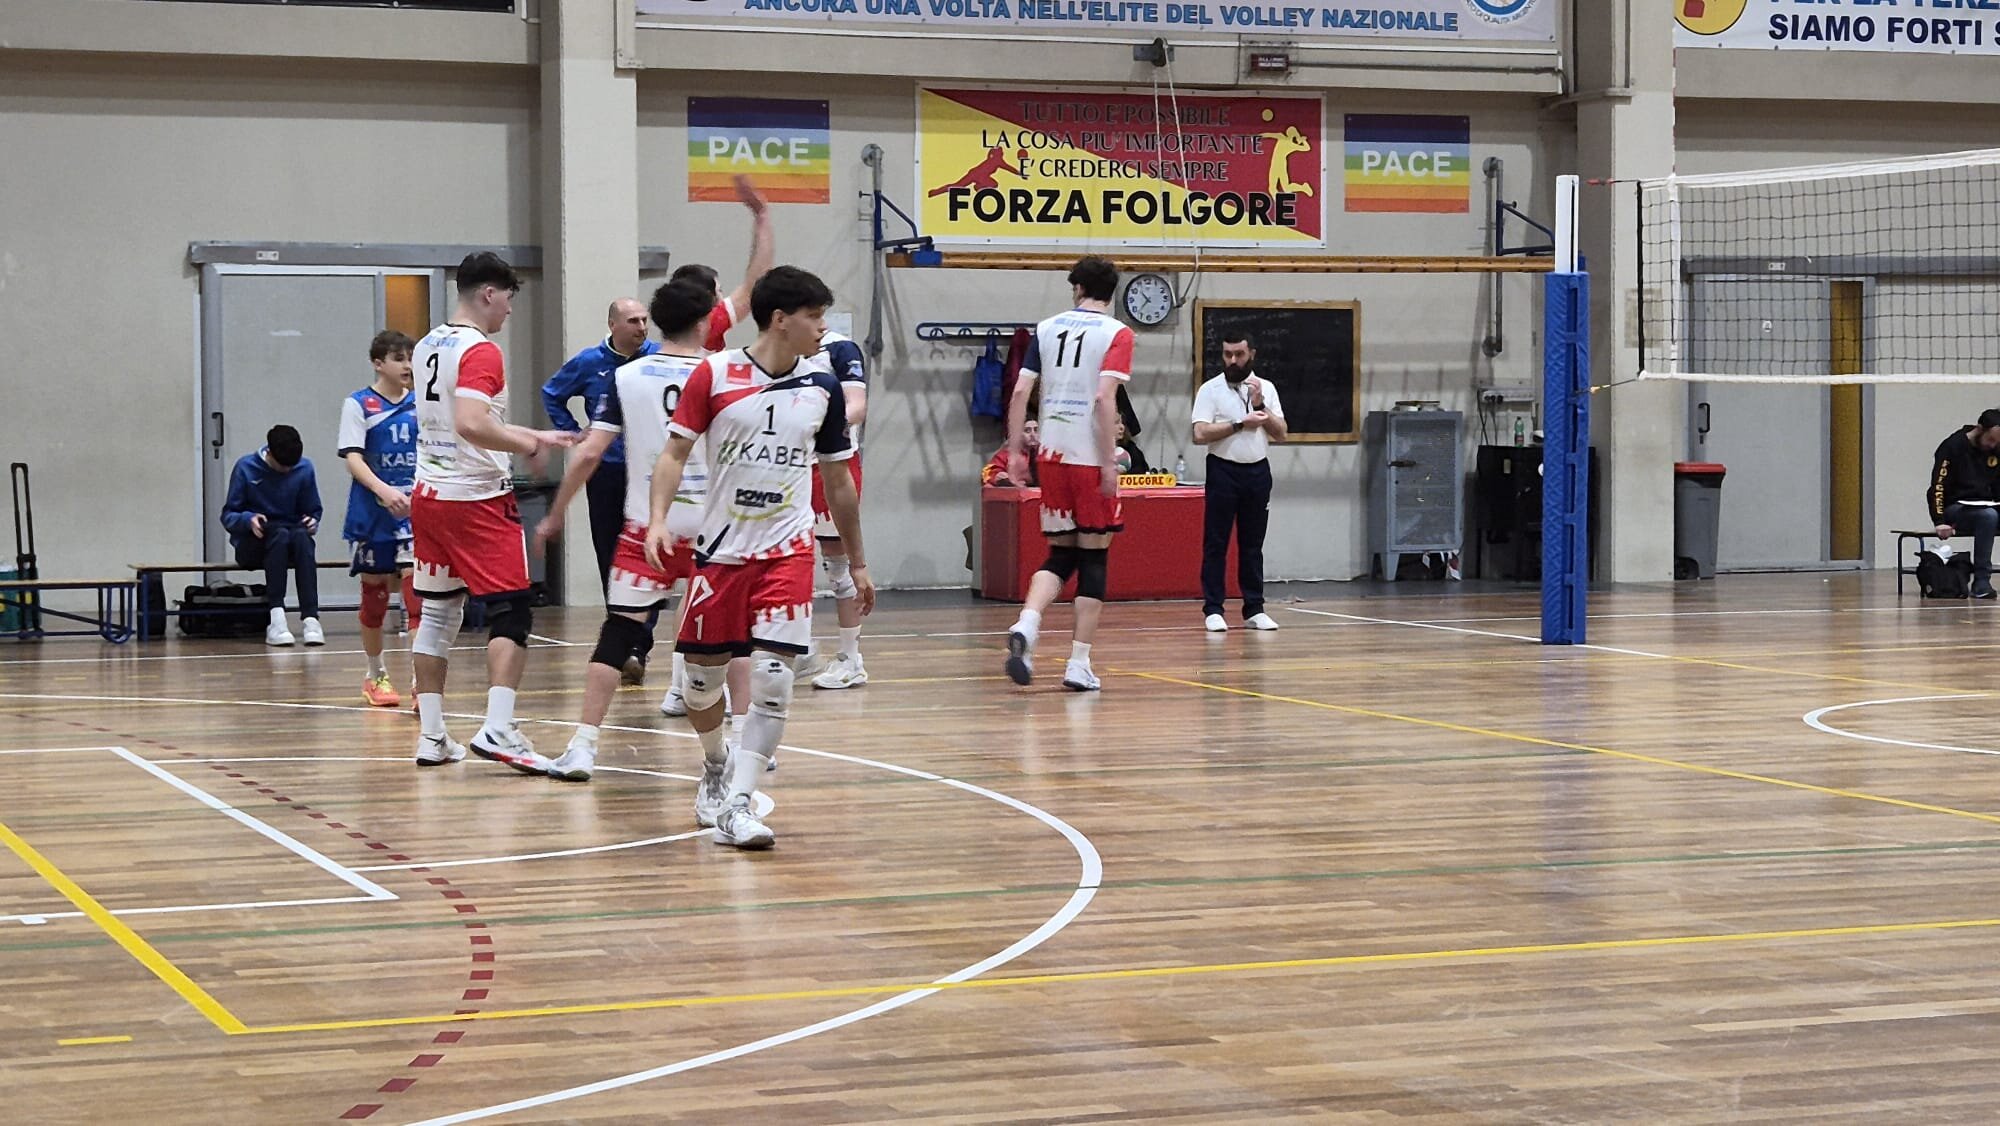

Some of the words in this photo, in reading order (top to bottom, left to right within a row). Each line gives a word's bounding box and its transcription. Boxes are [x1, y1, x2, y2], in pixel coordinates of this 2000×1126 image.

[865, 0, 921, 16] UNA
[929, 0, 1011, 18] VOLTA
[1018, 0, 1158, 22] NELL'ELITE
[1166, 4, 1213, 25] DEL
[1219, 6, 1315, 27] VOLLEY
[1321, 9, 1459, 31] NAZIONALE
[1768, 14, 1875, 42] SIAMO
[1887, 17, 1982, 46] FORTI
[1018, 101, 1099, 124] TUTTO
[1124, 104, 1231, 127] POSSIBILE
[707, 135, 811, 166] PACE
[982, 129, 1011, 149] LA
[1017, 130, 1075, 150] COSA
[1081, 131, 1121, 151] PIU'
[1126, 132, 1264, 155] IMPORTANTE
[1039, 159, 1141, 179] CREDERCI
[1148, 160, 1229, 181] SEMPRE
[1362, 150, 1452, 178] PACE
[948, 188, 1092, 224] FORZA
[1102, 189, 1297, 226] FOLGORE
[1055, 329, 1087, 369] 11
[425, 352, 441, 402] 2
[389, 423, 411, 444] 14
[762, 404, 777, 436] 1
[694, 613, 704, 641] 1
